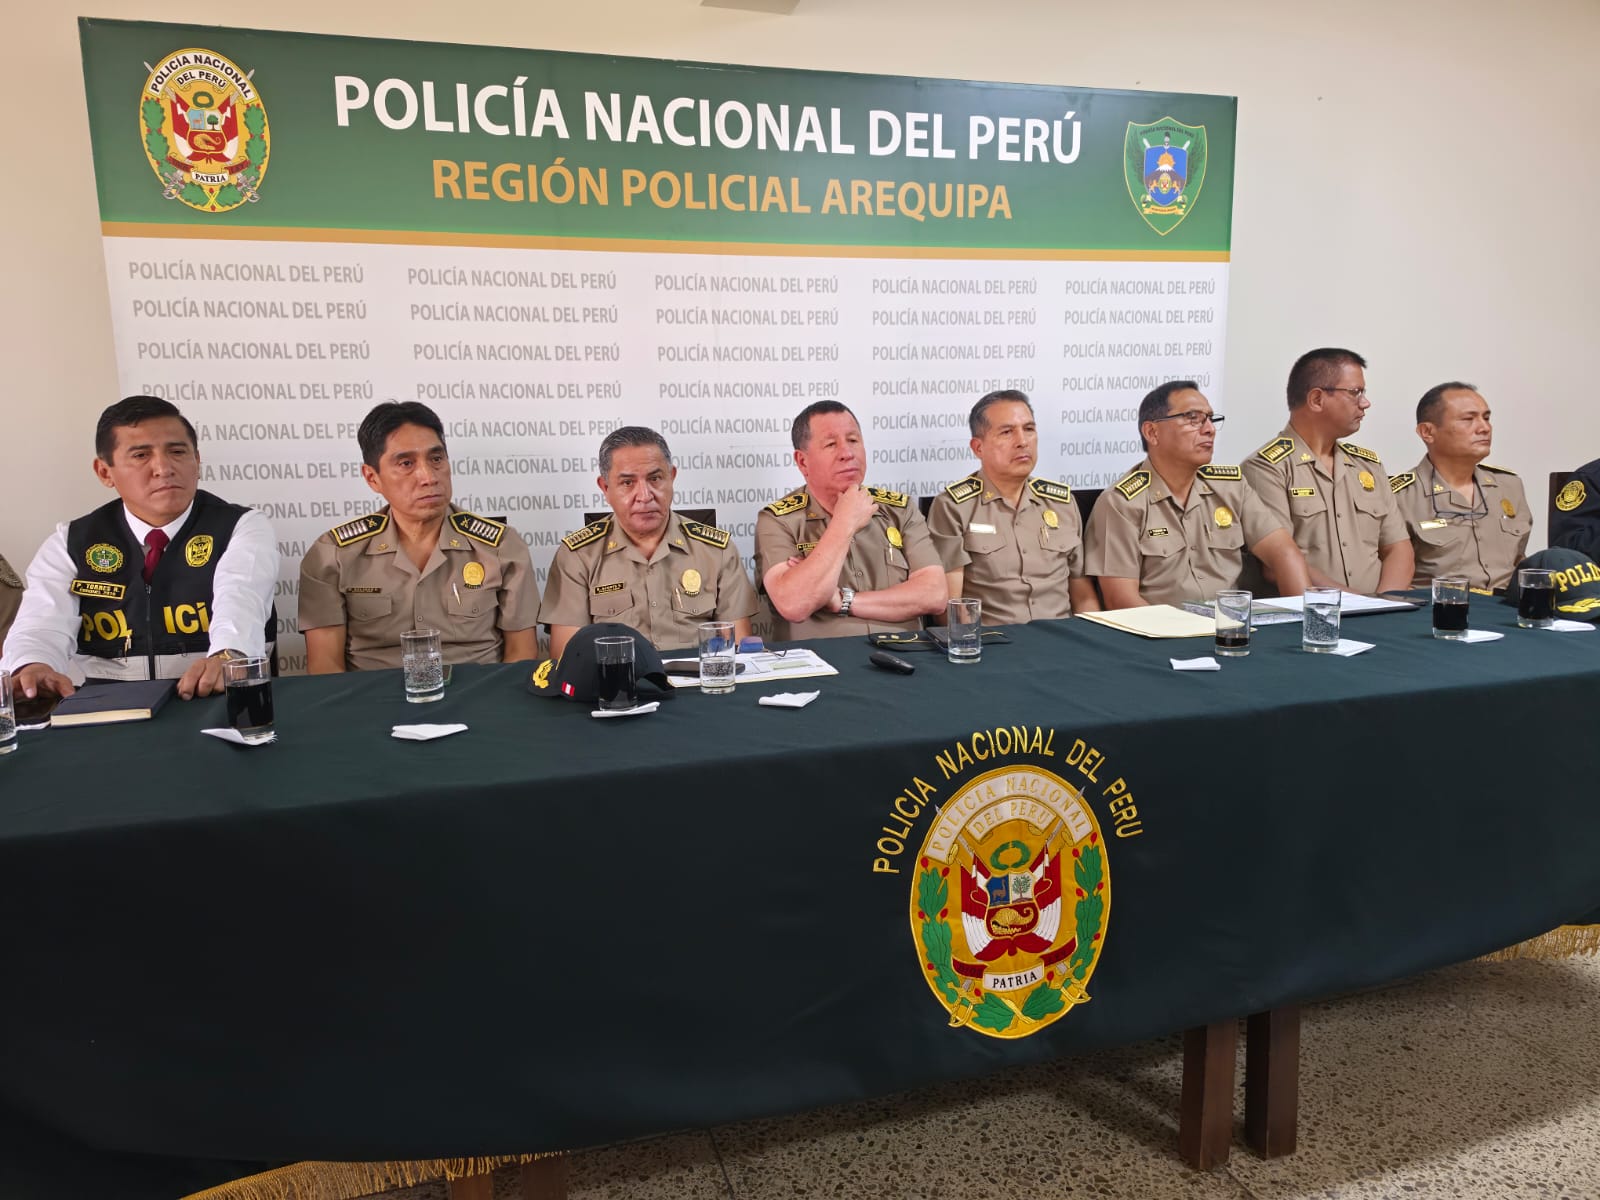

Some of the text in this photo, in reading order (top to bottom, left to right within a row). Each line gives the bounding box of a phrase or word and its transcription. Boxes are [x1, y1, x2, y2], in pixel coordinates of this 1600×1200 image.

[150, 54, 252, 98] POLICÍA NACIONAL
[176, 71, 227, 88] DEL PERÚ
[334, 75, 1082, 165] POLICÍA NACIONAL DEL PERÚ
[195, 173, 226, 183] PATRIA
[432, 156, 1013, 222] REGIÓN POLICIAL AREQUIPA
[129, 260, 363, 283] POLICÍA NACIONAL DEL PERÚ
[408, 267, 617, 290] POLICÍA NACIONAL DEL PERÚ
[655, 273, 839, 293] POLICÍA NACIONAL DEL PERÚ
[872, 276, 1037, 295] POLICÍA NACIONAL DEL PERÚ
[1065, 278, 1215, 295] POLICÍA NACIONAL DEL PERÚ
[133, 297, 367, 319] POLICÍA NACIONAL DEL PERÚ
[411, 302, 618, 324] POLICÍA NACIONAL DEL PERÚ
[656, 306, 839, 325] POLICÍA NACIONAL DEL PERÚ
[872, 308, 1036, 326] POLICÍA NACIONAL DEL PERÚ
[1065, 307, 1214, 325] POLICÍA NACIONAL DEL PERÚ
[138, 339, 370, 359] POLICÍA NACIONAL DEL PERÚ
[414, 341, 620, 361] POLICÍA NACIONAL DEL PERÚ
[658, 344, 839, 362] POLICÍA NACIONAL DEL PERÚ
[872, 342, 1035, 361] POLICÍA NACIONAL DEL PERÚ
[1064, 340, 1212, 358] POLICÍA NACIONAL DEL PERÚ
[143, 381, 373, 401] POLICÍA NACIONAL DEL PERÚ
[417, 381, 622, 400] POLICÍA NACIONAL DEL PERÚ
[659, 379, 839, 399] POLICÍA NACIONAL DEL PERÚ
[872, 378, 918, 396] POLICÍA
[921, 380, 980, 394] NACIONAL
[1063, 374, 1104, 391] POLICÍA
[872, 413, 969, 430] POLICÍA NACION
[1062, 407, 1138, 424] POLICÍA NACIO
[216, 424, 299, 441] NACIONAL
[304, 424, 333, 439] DEL
[337, 423, 360, 439] PE
[445, 419, 478, 438] ICÍA
[482, 421, 556, 437] NACIONAL
[560, 421, 585, 436] DEL
[661, 417, 712, 434] POLICÍA
[715, 419, 779, 434] NACIONAL
[872, 446, 917, 463] POLICÍA
[1061, 439, 1102, 456] POLICÍA
[451, 456, 481, 476] ICÍA
[484, 458, 558, 474] NACIONAL
[562, 458, 587, 472] DEL
[671, 452, 713, 470] OLICÍA
[717, 453, 780, 469] NACIONAL
[220, 464, 303, 481] NACIONAL
[307, 463, 337, 478] DEL
[340, 462, 363, 478] PE
[487, 495, 560, 511] NACIONAL
[564, 494, 589, 509] DEL
[672, 488, 714, 506] OLICÍA
[311, 502, 340, 518] DEL
[81, 602, 210, 642] POL ICÍ
[873, 725, 1143, 874] POLICIA NACIONAL DEL PERU
[933, 776, 1086, 851] POLICIA NACIONAL
[974, 802, 1051, 835] DEL PERU
[992, 971, 1038, 989] PATRIA
